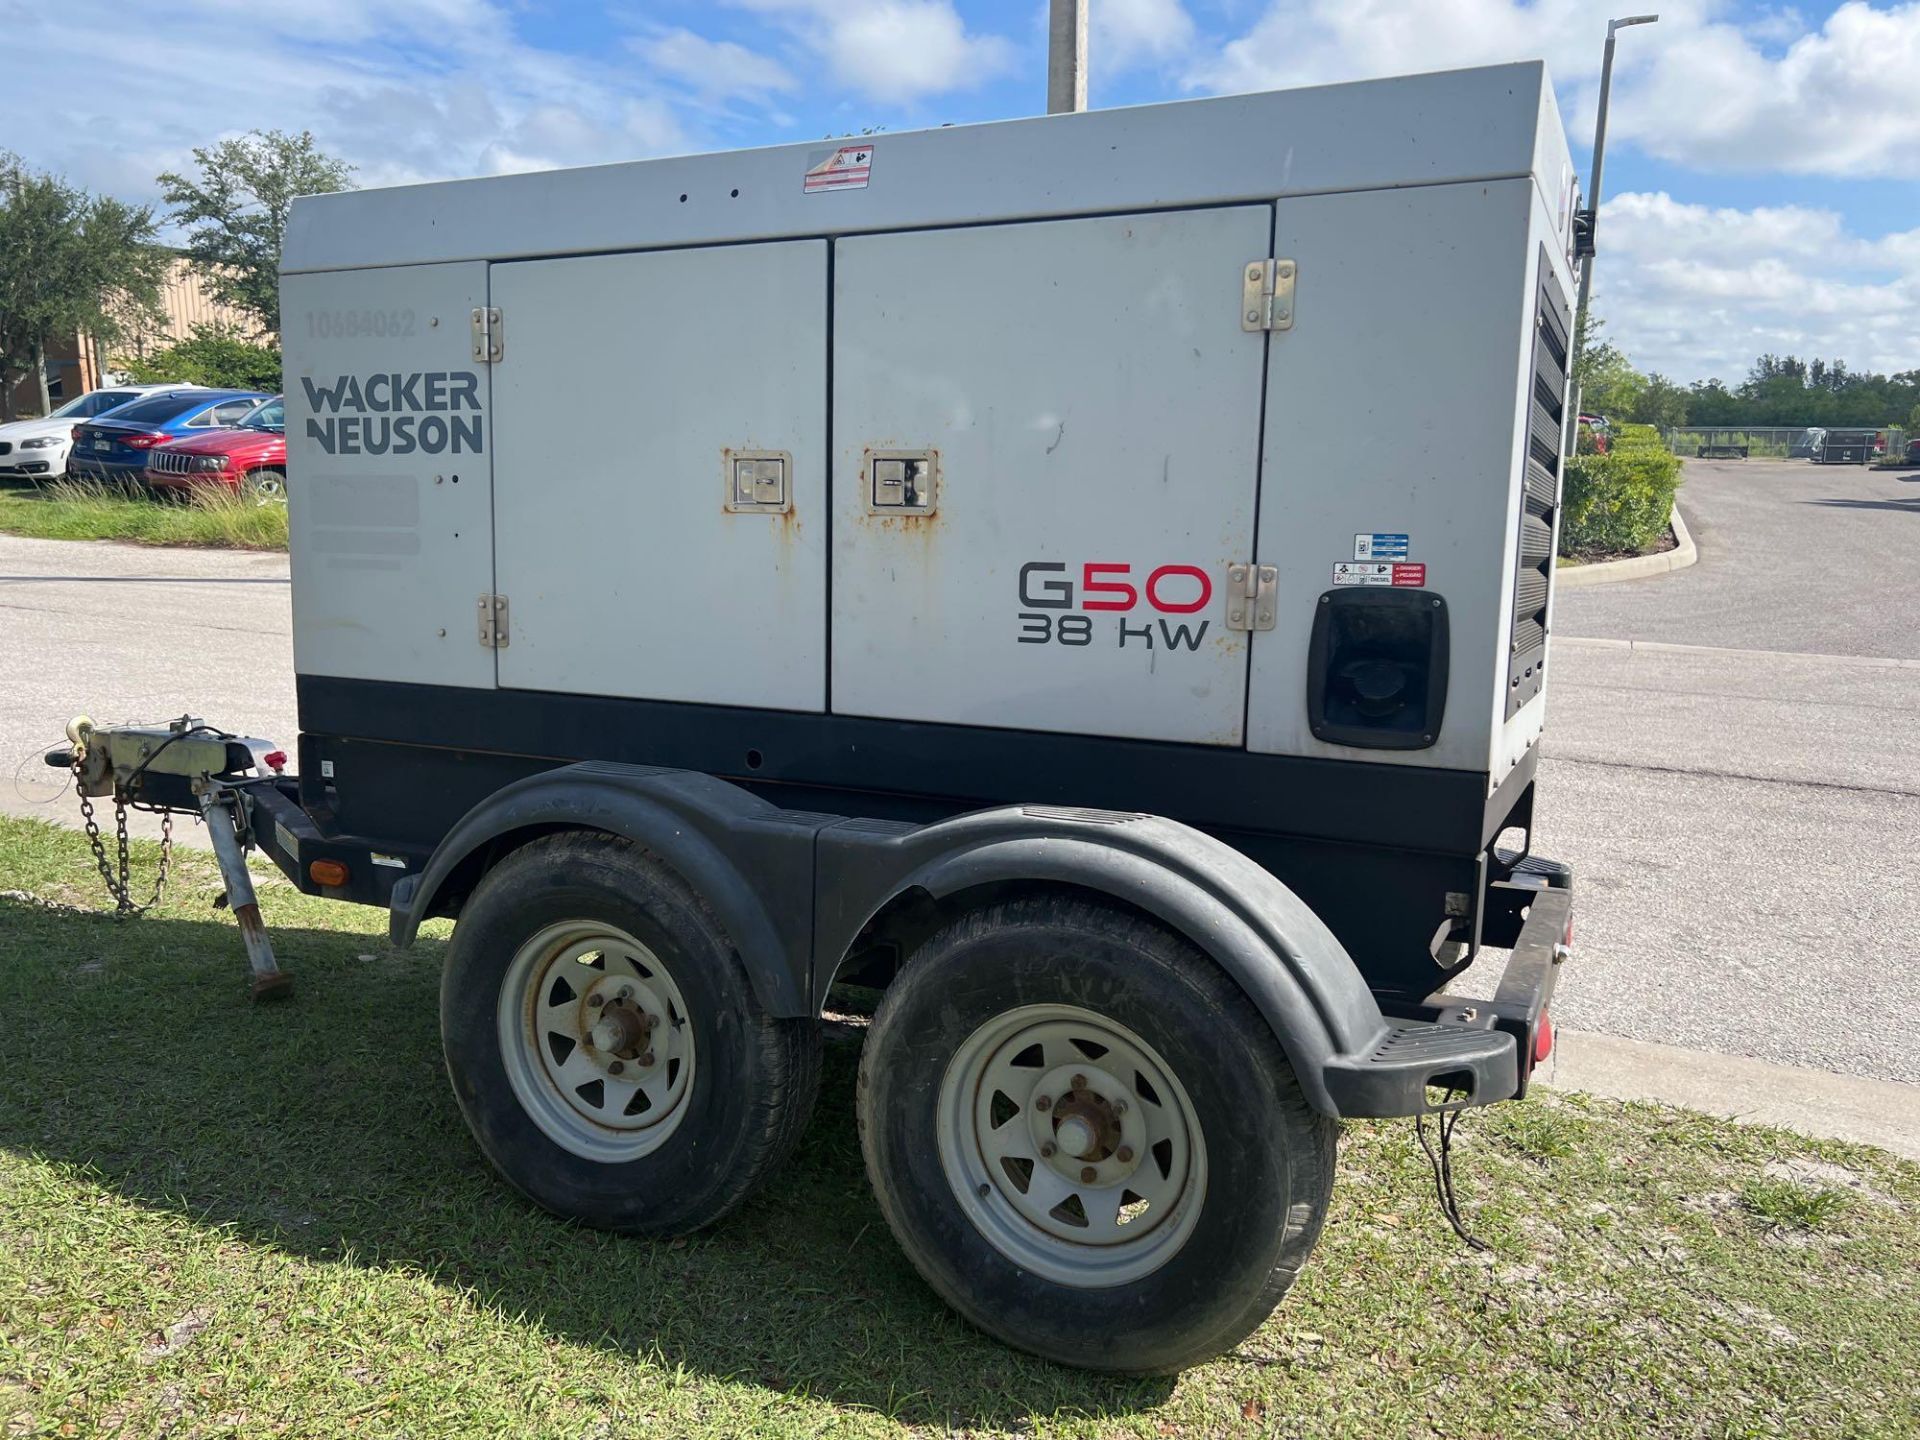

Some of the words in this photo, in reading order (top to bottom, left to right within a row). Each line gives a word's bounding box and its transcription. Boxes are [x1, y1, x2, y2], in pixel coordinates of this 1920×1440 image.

[301, 371, 482, 413] WACKER
[306, 415, 482, 455] NEUSON
[1019, 562, 1212, 613] G50
[1017, 613, 1093, 646] 38
